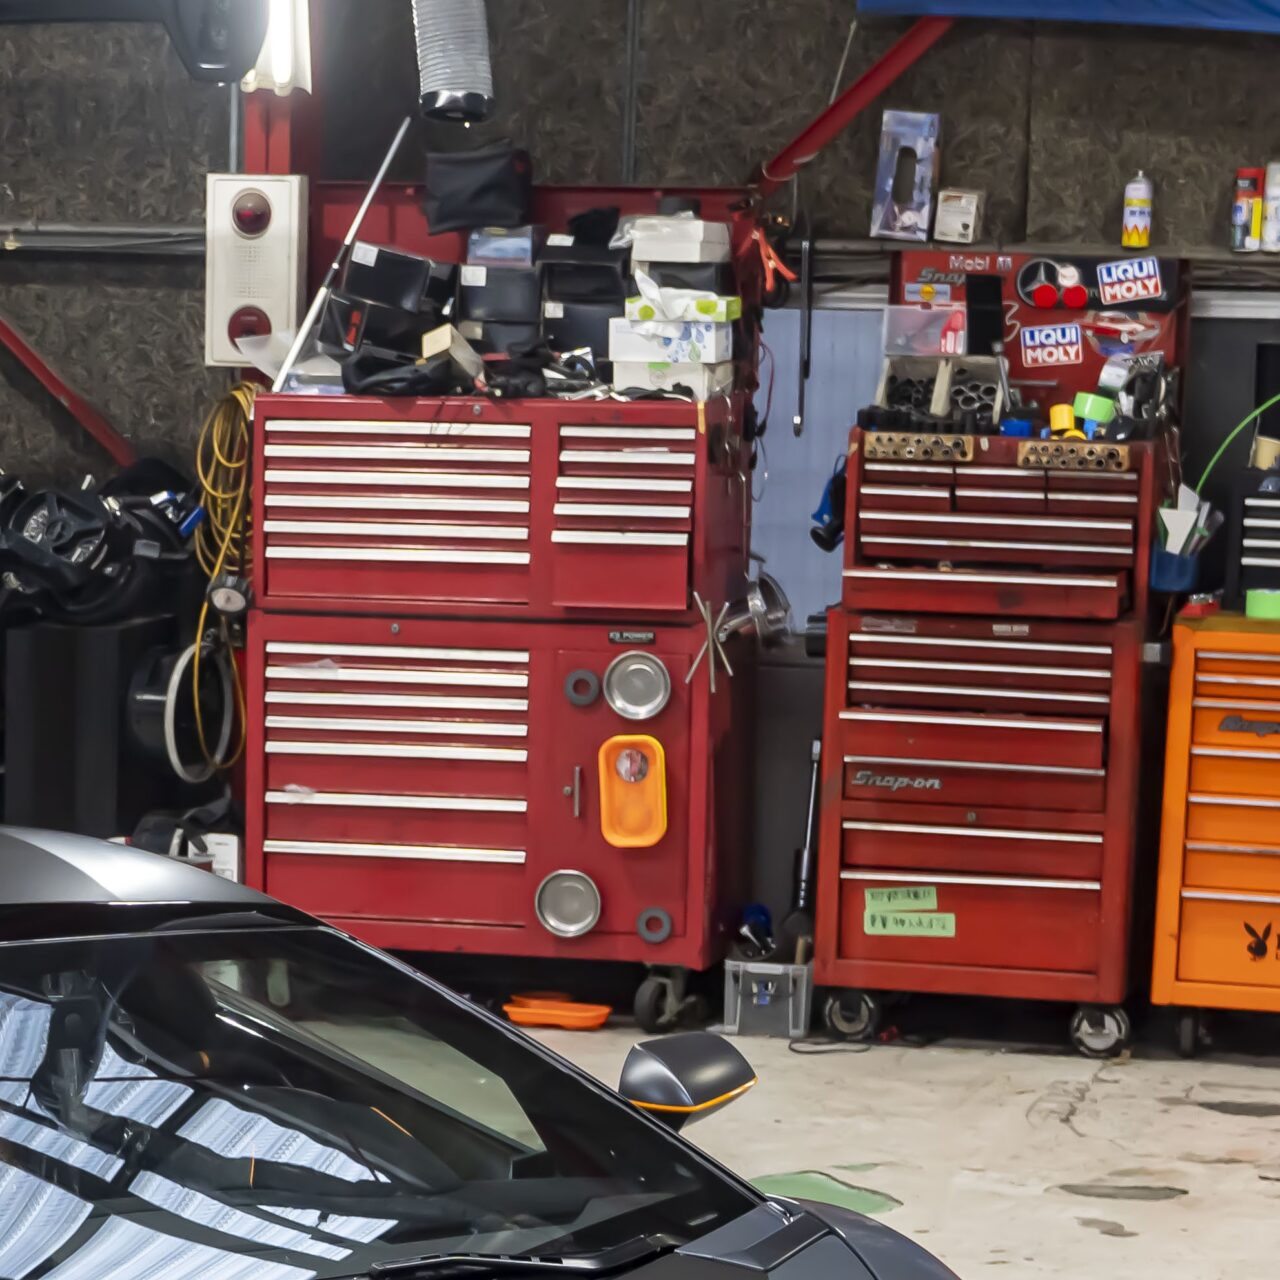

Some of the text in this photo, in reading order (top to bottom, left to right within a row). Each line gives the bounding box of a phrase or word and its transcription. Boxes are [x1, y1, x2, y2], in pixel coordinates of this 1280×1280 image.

[1101, 260, 1155, 283] LIQUI
[1104, 277, 1158, 300] MOLY
[1024, 327, 1077, 347] LIQUI
[1026, 345, 1079, 364] MOLY
[851, 770, 941, 791] Snap-on
